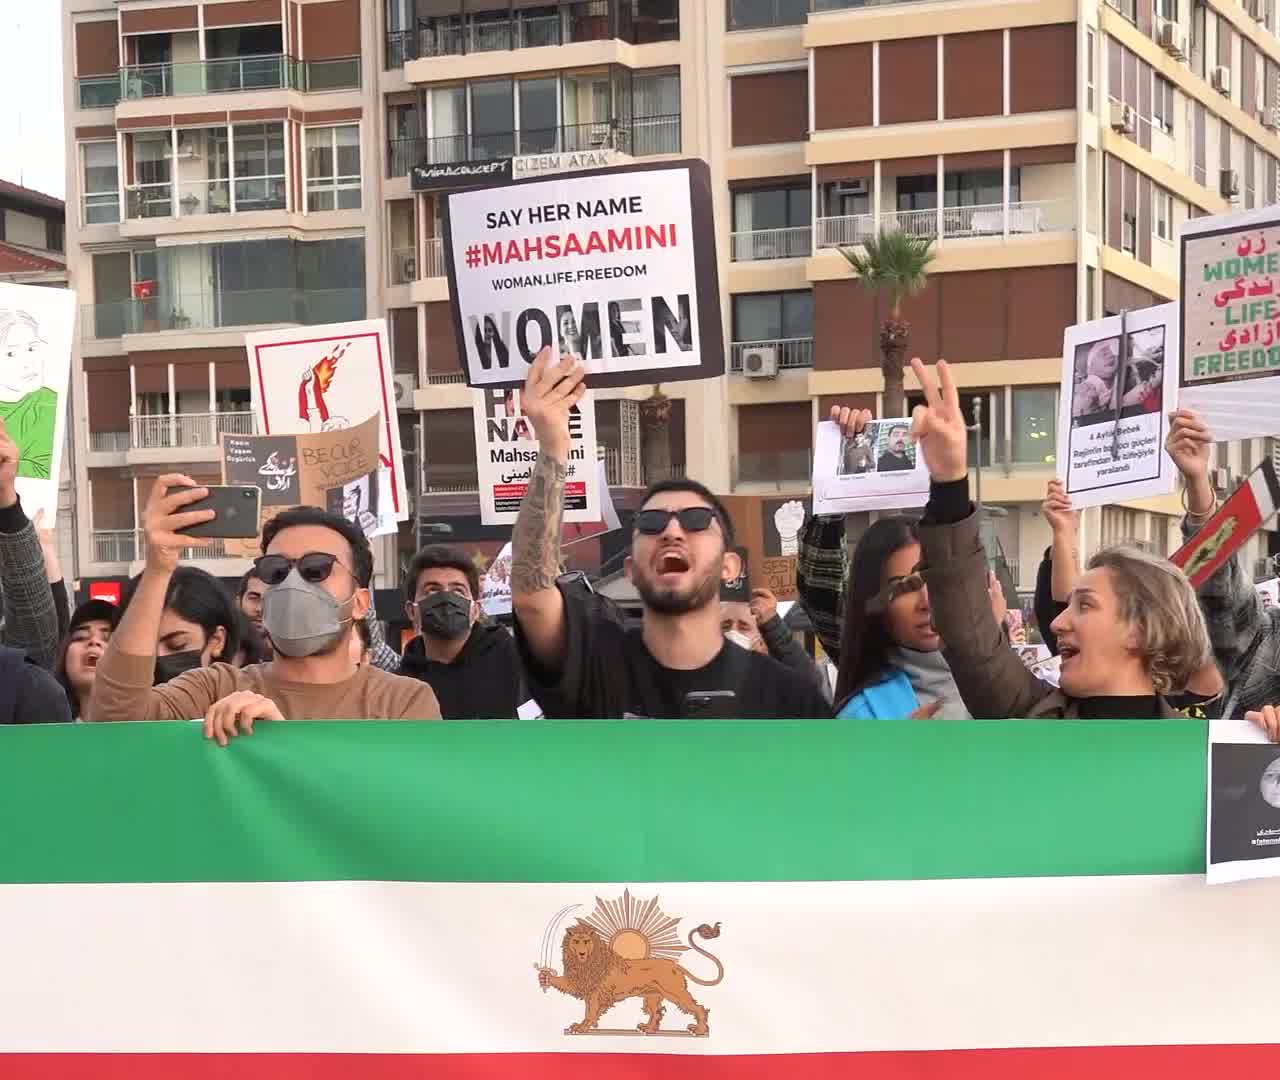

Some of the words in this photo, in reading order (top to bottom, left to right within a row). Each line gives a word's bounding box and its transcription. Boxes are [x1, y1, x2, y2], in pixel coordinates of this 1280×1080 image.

[569, 153, 608, 168] ATAK
[486, 209, 523, 229] SAY
[529, 203, 569, 224] HER
[577, 196, 642, 219] NAME
[465, 223, 677, 269] #MAHSAAMINI
[1236, 230, 1266, 257] زن
[492, 264, 647, 291] WOMAN,LIFE,FREEDOM
[1225, 299, 1277, 325] LIFE
[468, 294, 693, 370] WOMEN
[486, 416, 583, 443] NAE
